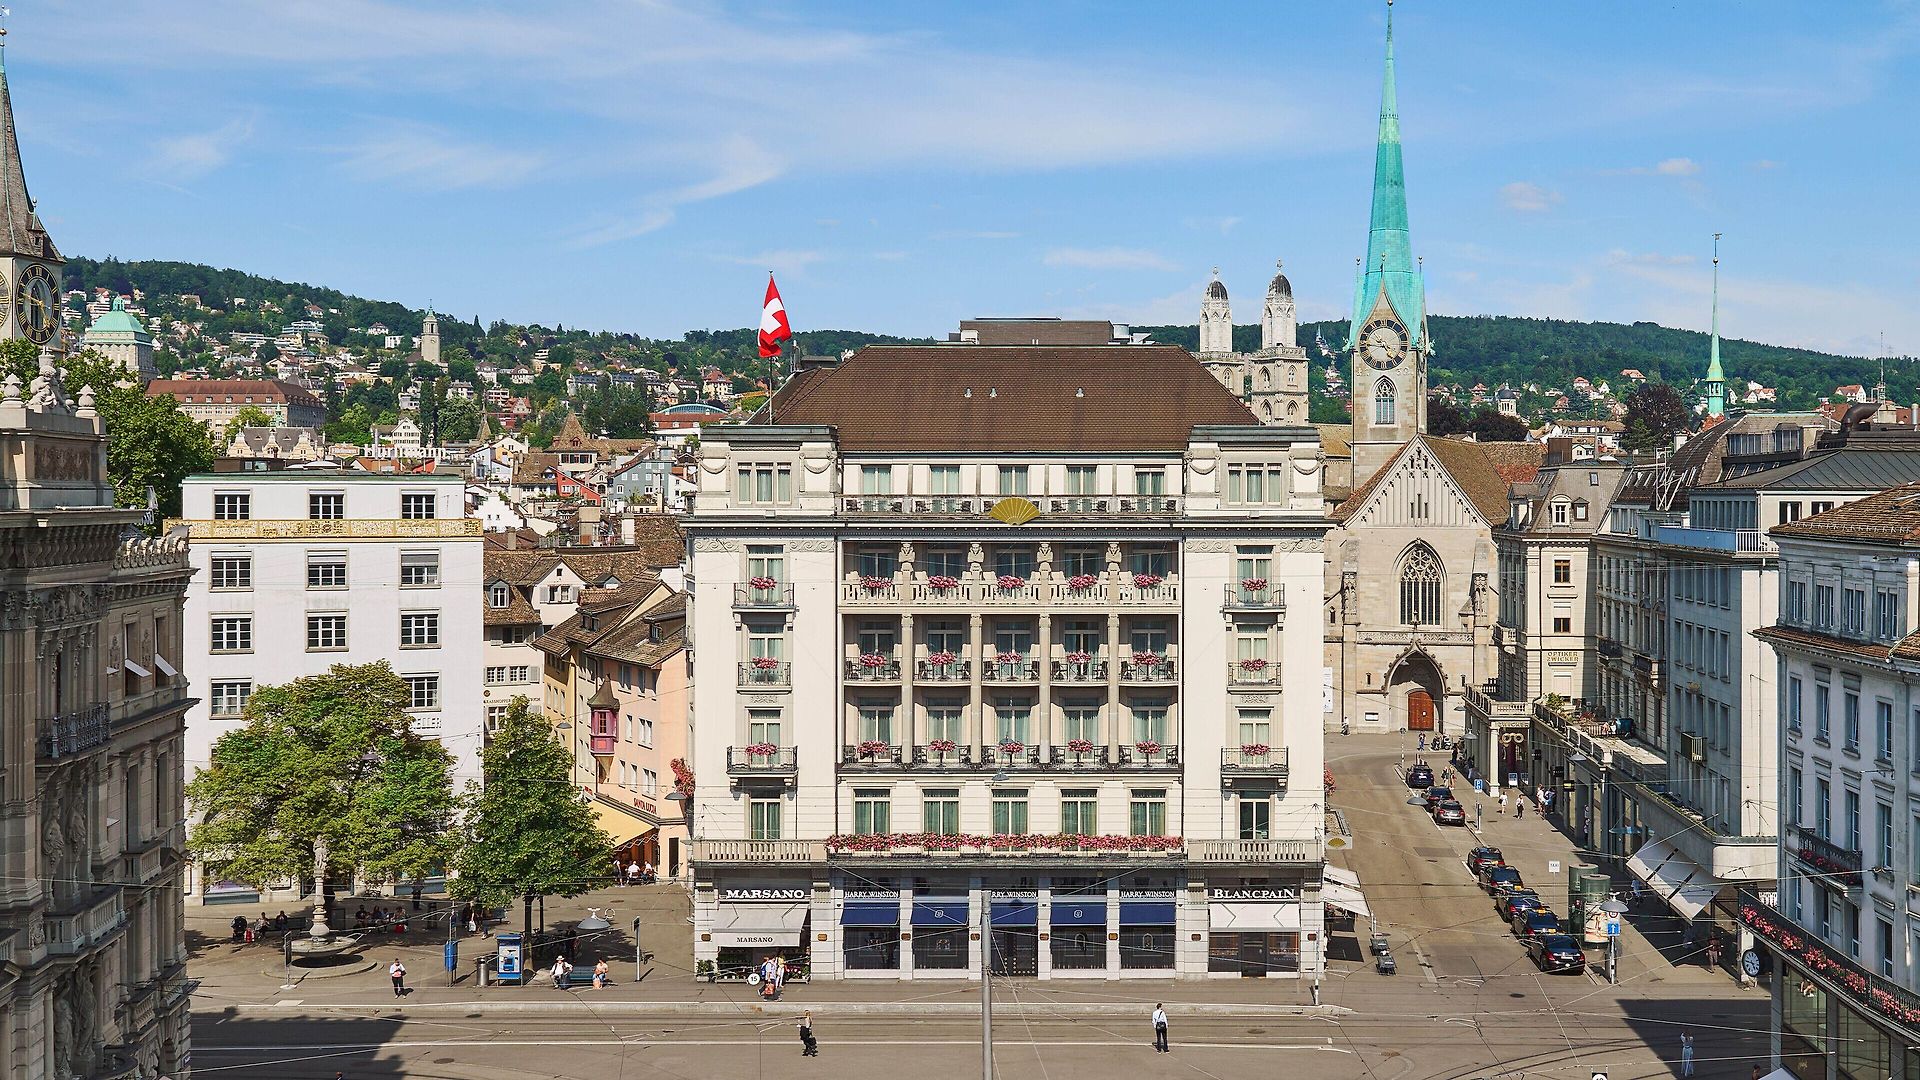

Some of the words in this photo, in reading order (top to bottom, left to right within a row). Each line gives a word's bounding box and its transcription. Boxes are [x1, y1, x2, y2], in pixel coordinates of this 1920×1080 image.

[726, 889, 805, 899] MARSANO
[844, 890, 867, 898] HARRY
[868, 890, 899, 898] WINSTON
[991, 890, 1006, 898] RRY
[1006, 890, 1037, 898] WINSTON
[1120, 890, 1143, 898] HARRY
[1144, 890, 1175, 898] WINSTON
[1213, 888, 1296, 899] BLANCPAIN
